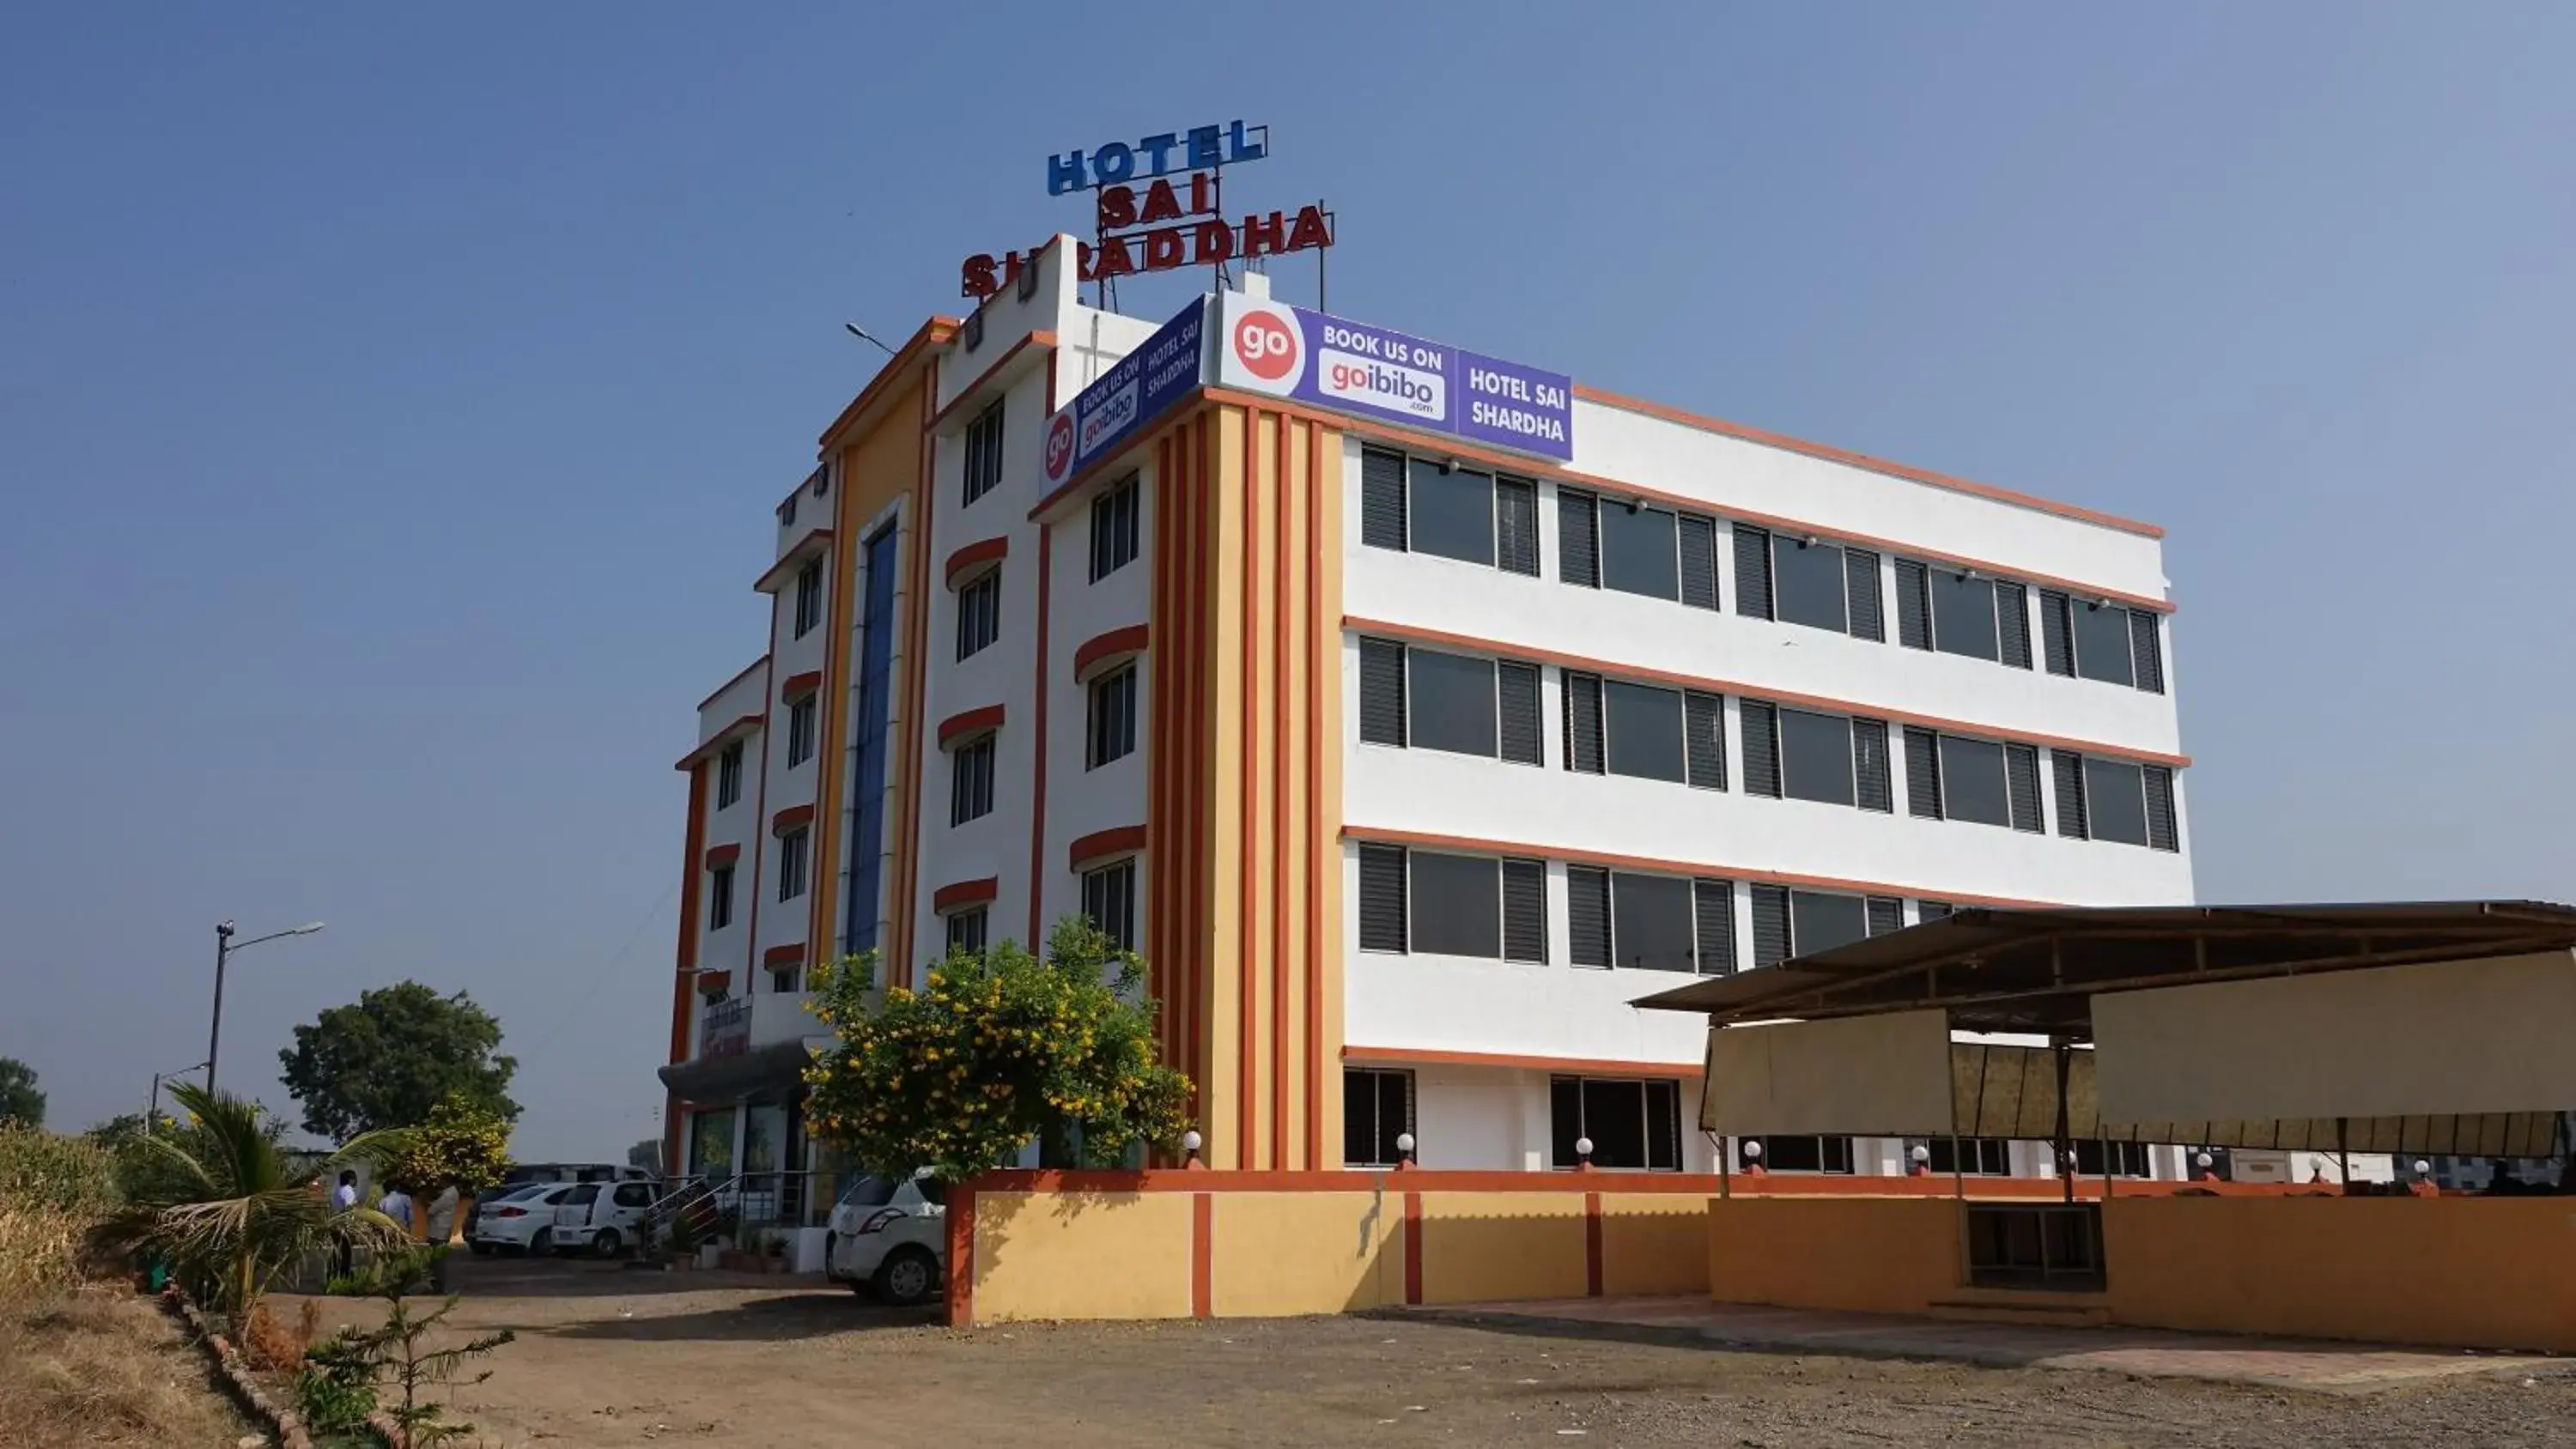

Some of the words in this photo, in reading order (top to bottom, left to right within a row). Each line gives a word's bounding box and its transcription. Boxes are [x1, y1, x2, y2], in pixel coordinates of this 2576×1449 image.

[1048, 120, 1264, 196] HOTEL
[1102, 173, 1212, 228] SAI
[1146, 339, 1180, 372] HOTEL
[1181, 320, 1200, 346] SAI
[1242, 324, 1288, 359] go
[1323, 325, 1379, 355] BOOK
[1385, 342, 1408, 361] US
[1413, 348, 1443, 372] ON
[1084, 383, 1109, 413] BOOK
[1109, 373, 1123, 394] US
[1124, 355, 1140, 380] ON
[1146, 350, 1195, 397] SHARDHA
[1332, 361, 1434, 404] goibibo
[1469, 367, 1531, 403] HOTEL
[1534, 383, 1566, 410] SAI
[1472, 401, 1564, 443] SHARDHA
[1047, 426, 1071, 466] go
